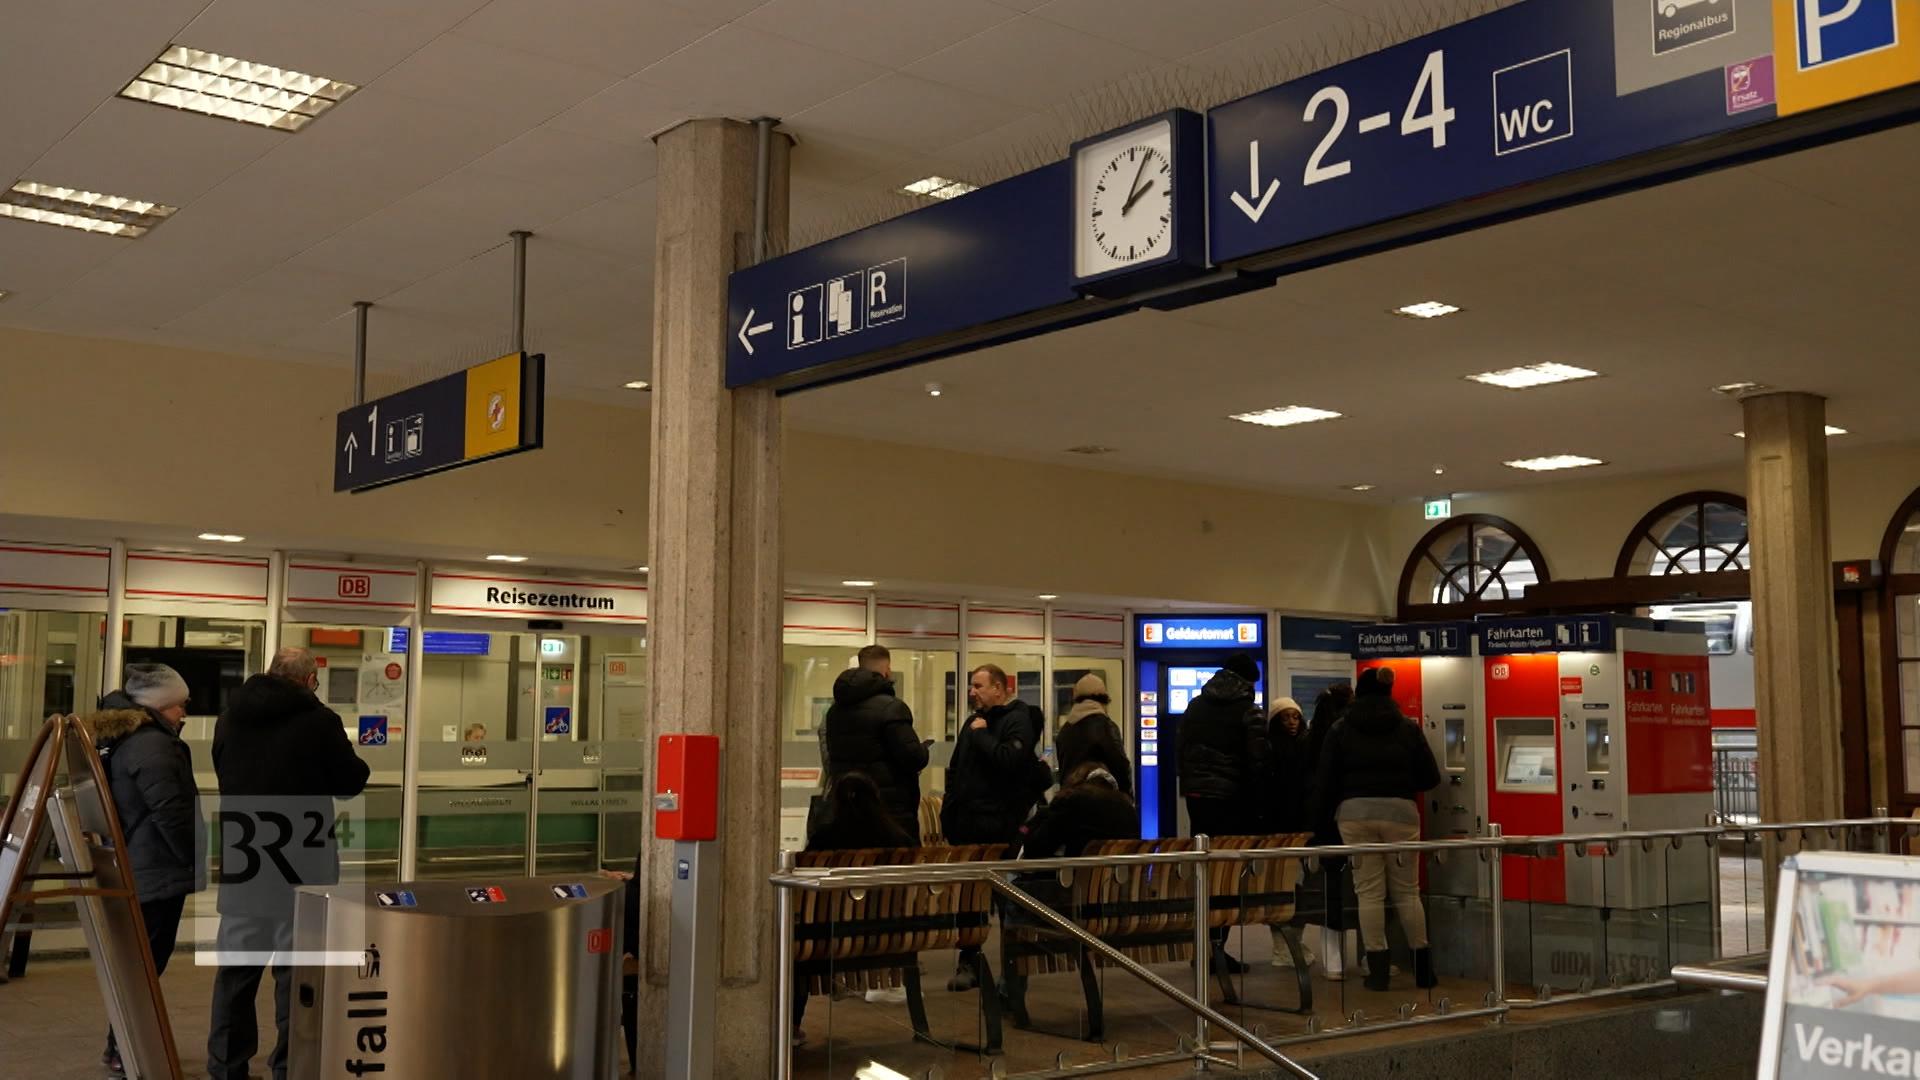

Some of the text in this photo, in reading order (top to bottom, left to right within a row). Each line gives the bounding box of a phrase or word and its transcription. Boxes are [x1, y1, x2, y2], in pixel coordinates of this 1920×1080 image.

[1659, 13, 1729, 41] Regionalbus
[1303, 49, 1455, 186] 2-4
[1500, 99, 1554, 142] WC
[870, 270, 887, 306] R
[870, 304, 903, 319] Reservation
[368, 405, 378, 456] 1
[341, 578, 367, 595] DB
[486, 585, 615, 611] Reisezentrum
[1166, 627, 1234, 640] Geldautomat
[1358, 633, 1409, 644] Fahrkarten
[1487, 627, 1544, 640] Fahrkarten
[1793, 1022, 1920, 1079] Verka
